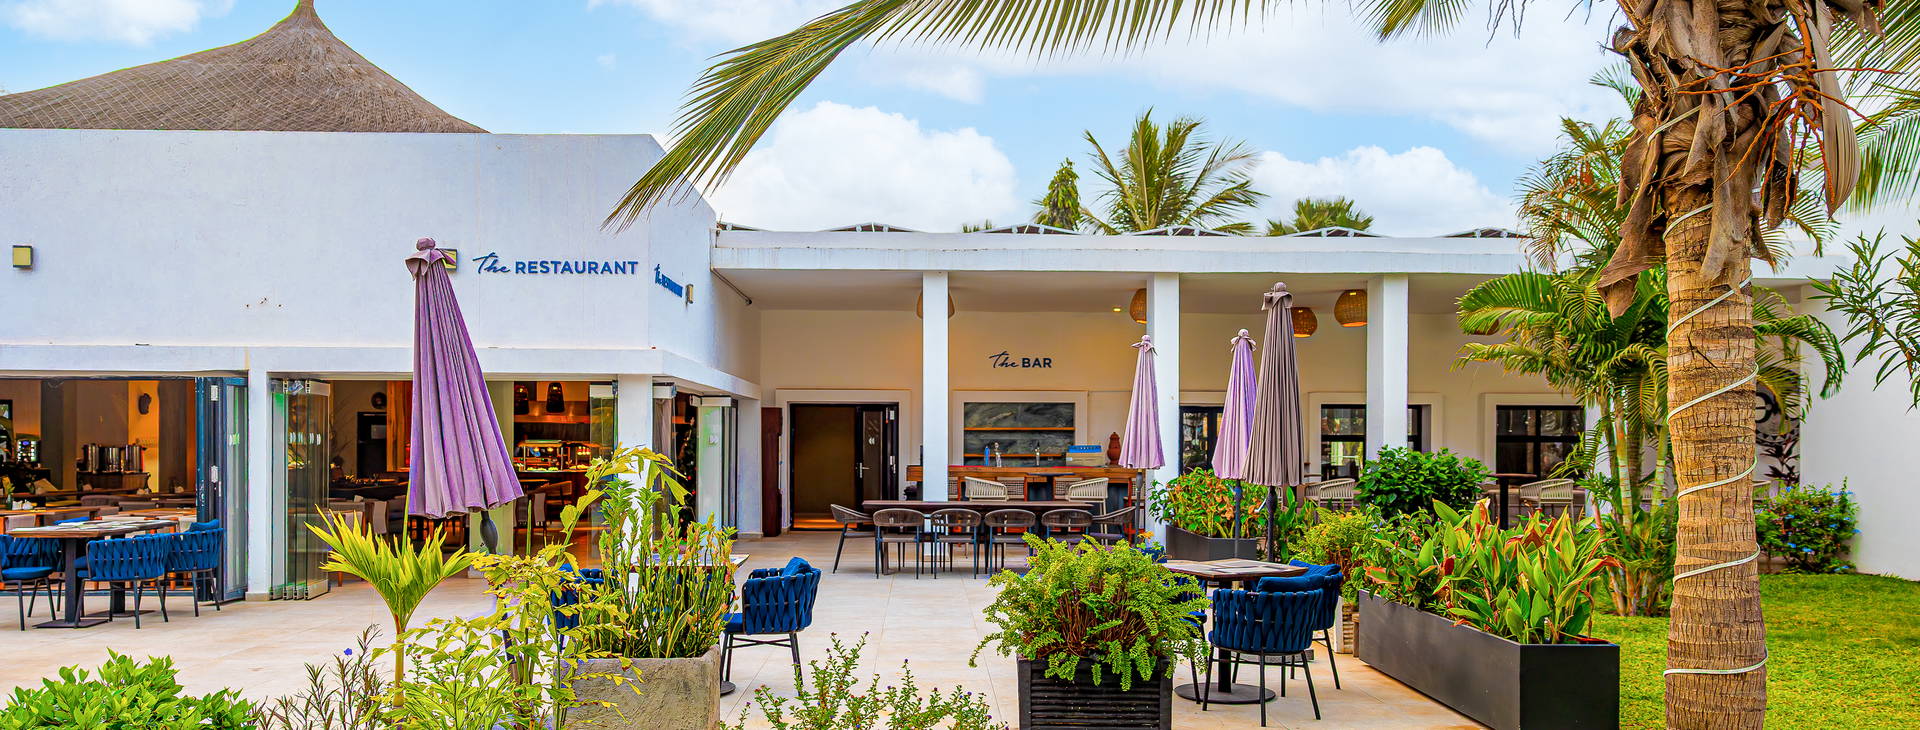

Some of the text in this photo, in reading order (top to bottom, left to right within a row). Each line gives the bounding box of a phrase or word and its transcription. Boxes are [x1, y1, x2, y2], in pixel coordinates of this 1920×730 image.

[472, 252, 638, 275] The RESTAURANT
[989, 351, 1052, 368] The BAR
